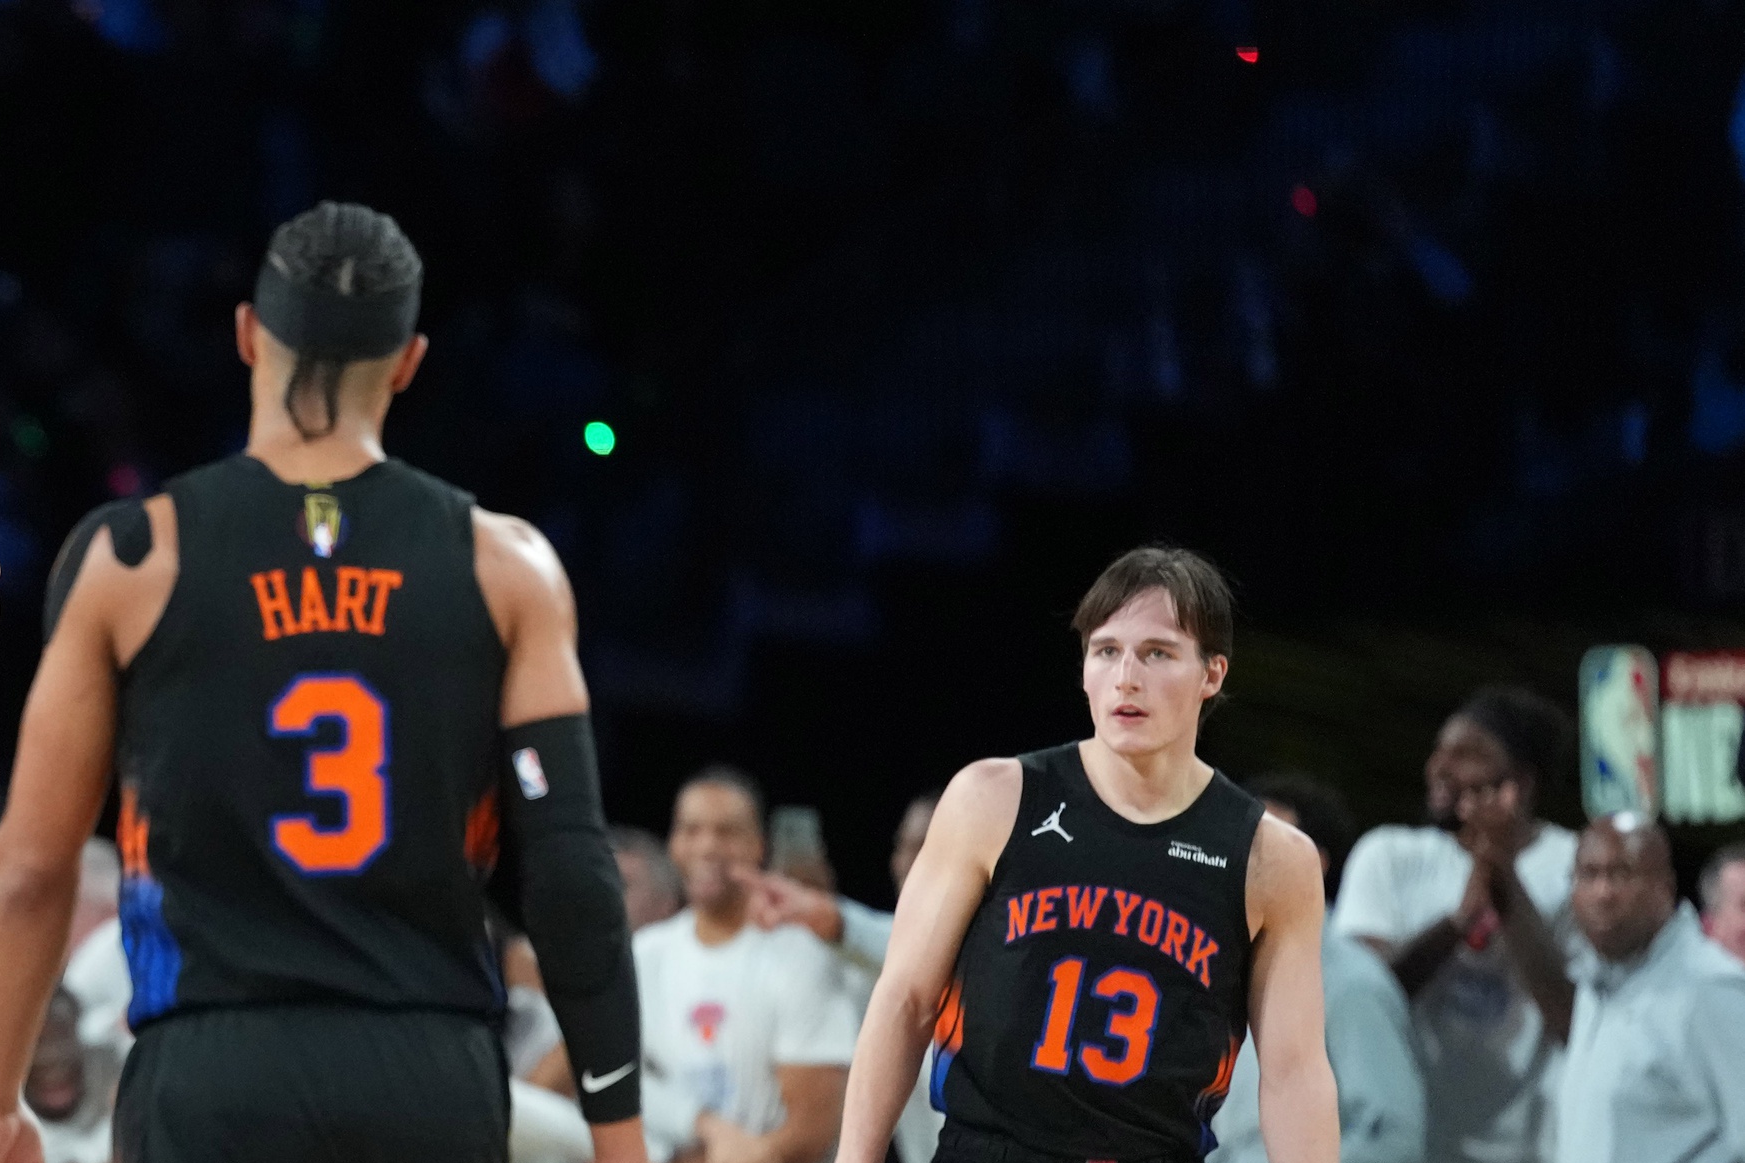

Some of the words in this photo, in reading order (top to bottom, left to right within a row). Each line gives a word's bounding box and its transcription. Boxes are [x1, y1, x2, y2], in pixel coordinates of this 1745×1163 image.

[248, 565, 405, 642] HART
[266, 669, 393, 879] 3
[1004, 885, 1109, 945] NEW
[1112, 887, 1221, 990] YORK
[1029, 953, 1164, 1088] 13
